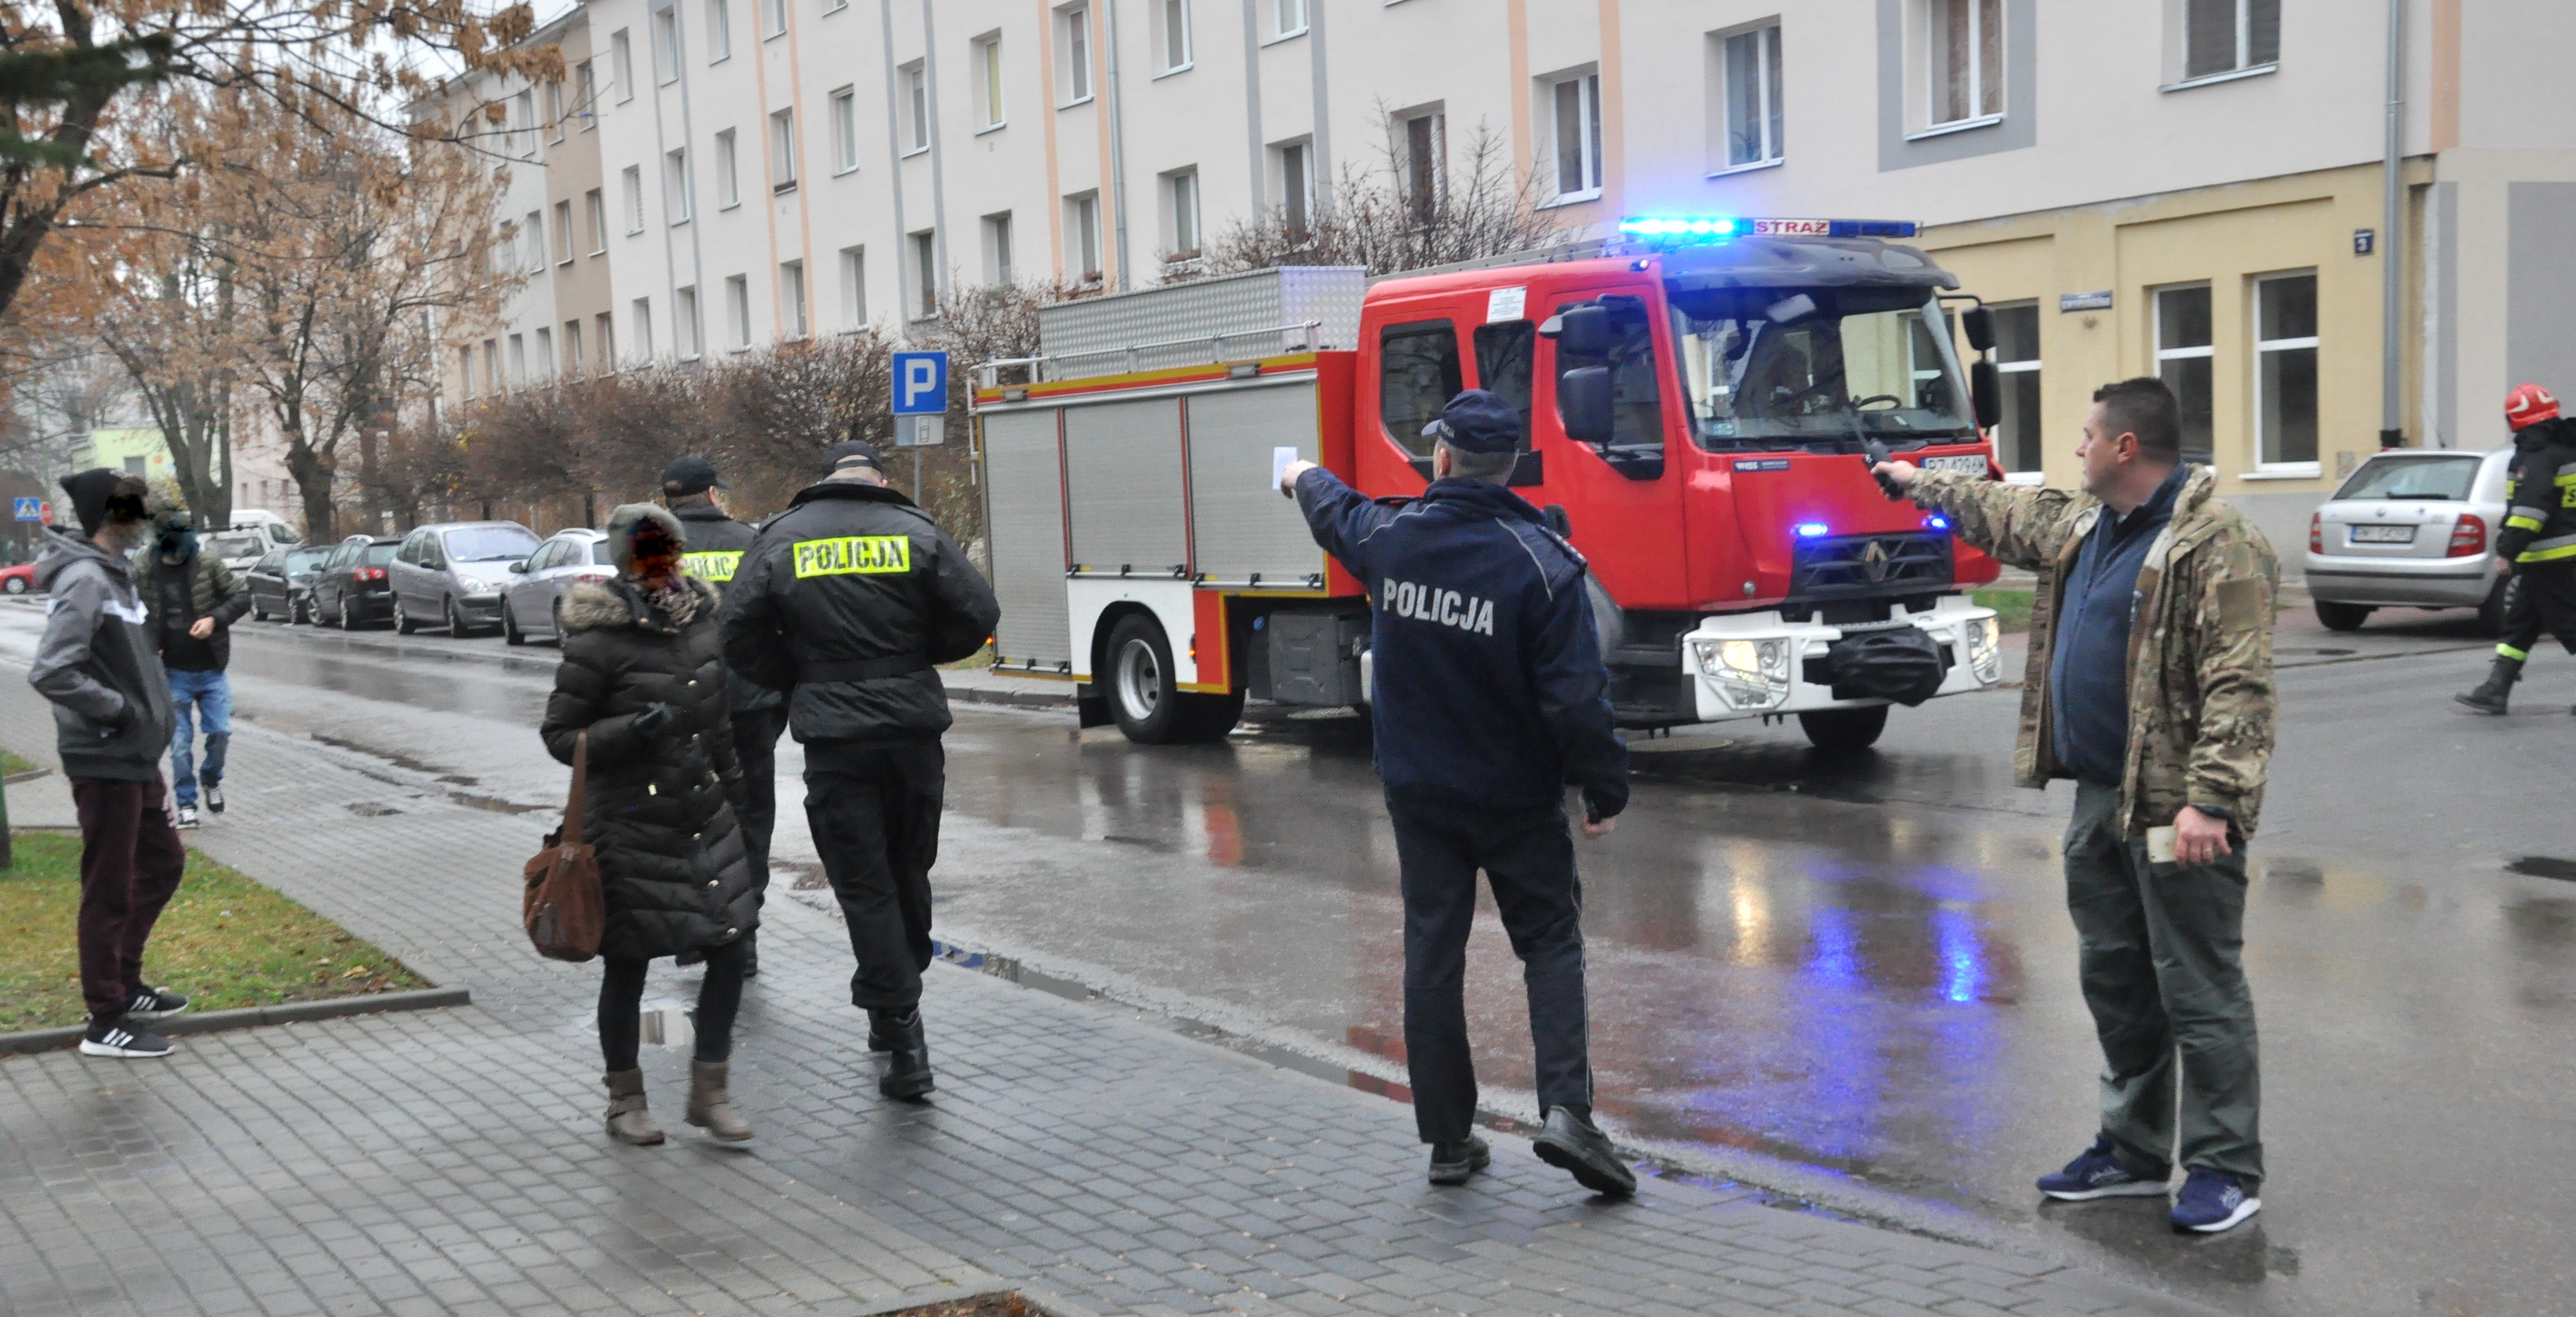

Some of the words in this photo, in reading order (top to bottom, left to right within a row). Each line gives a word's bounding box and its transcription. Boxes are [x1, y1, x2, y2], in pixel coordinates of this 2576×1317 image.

[905, 359, 937, 407] P
[684, 556, 732, 577] OLIC
[798, 540, 904, 573] POLICJA
[1383, 577, 1493, 637] POLICJA
